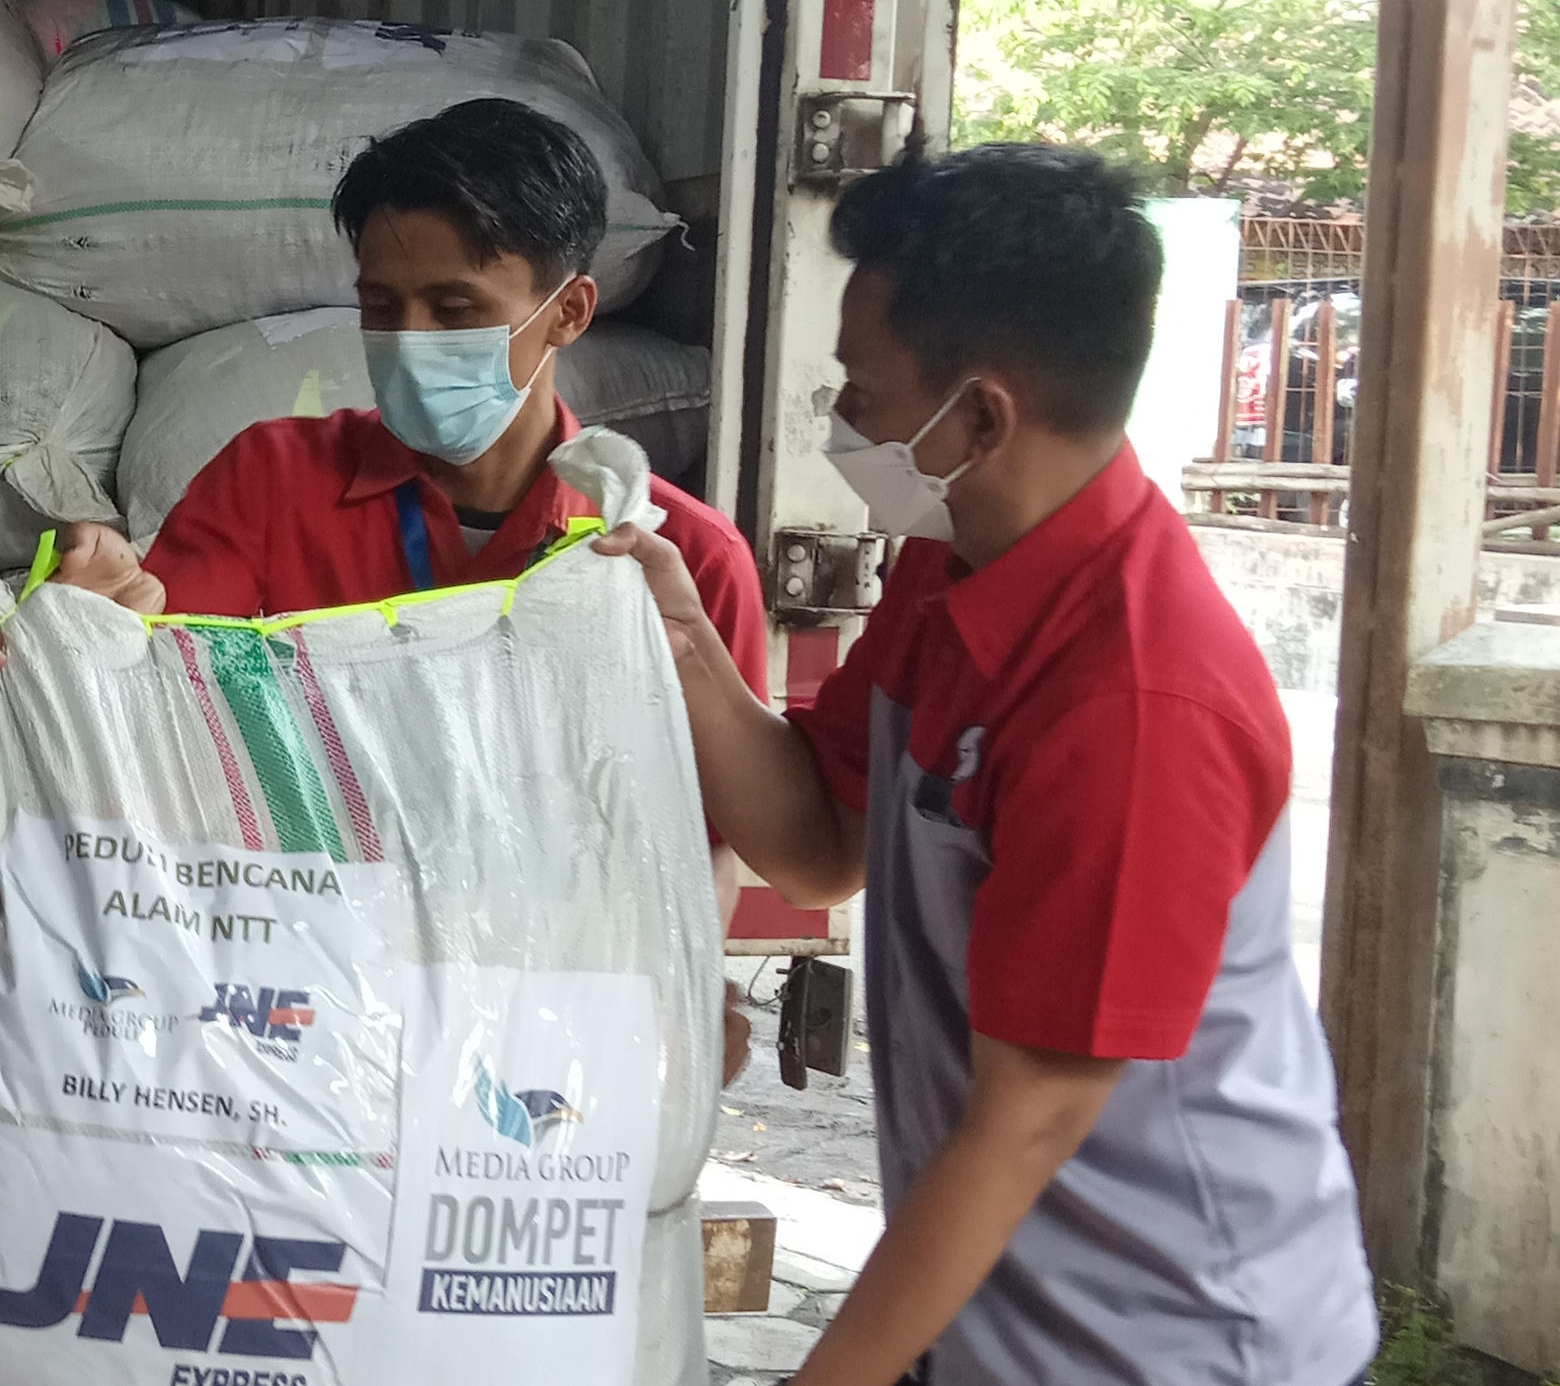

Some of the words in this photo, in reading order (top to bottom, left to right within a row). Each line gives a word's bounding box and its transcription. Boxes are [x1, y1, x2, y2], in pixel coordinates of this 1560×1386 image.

[175, 859, 344, 897] BENCANA
[102, 889, 201, 937] ALAM
[210, 913, 278, 945] NTT
[190, 981, 316, 1043] JNE
[62, 1072, 128, 1105] BILLY
[133, 1083, 241, 1125] HENSEN,
[247, 1099, 290, 1128] SH.
[433, 1143, 532, 1182] MEDIA
[536, 1151, 632, 1184] GROUP
[424, 1192, 626, 1266] DOMPET
[430, 1272, 611, 1313] KEMANUSIAAN
